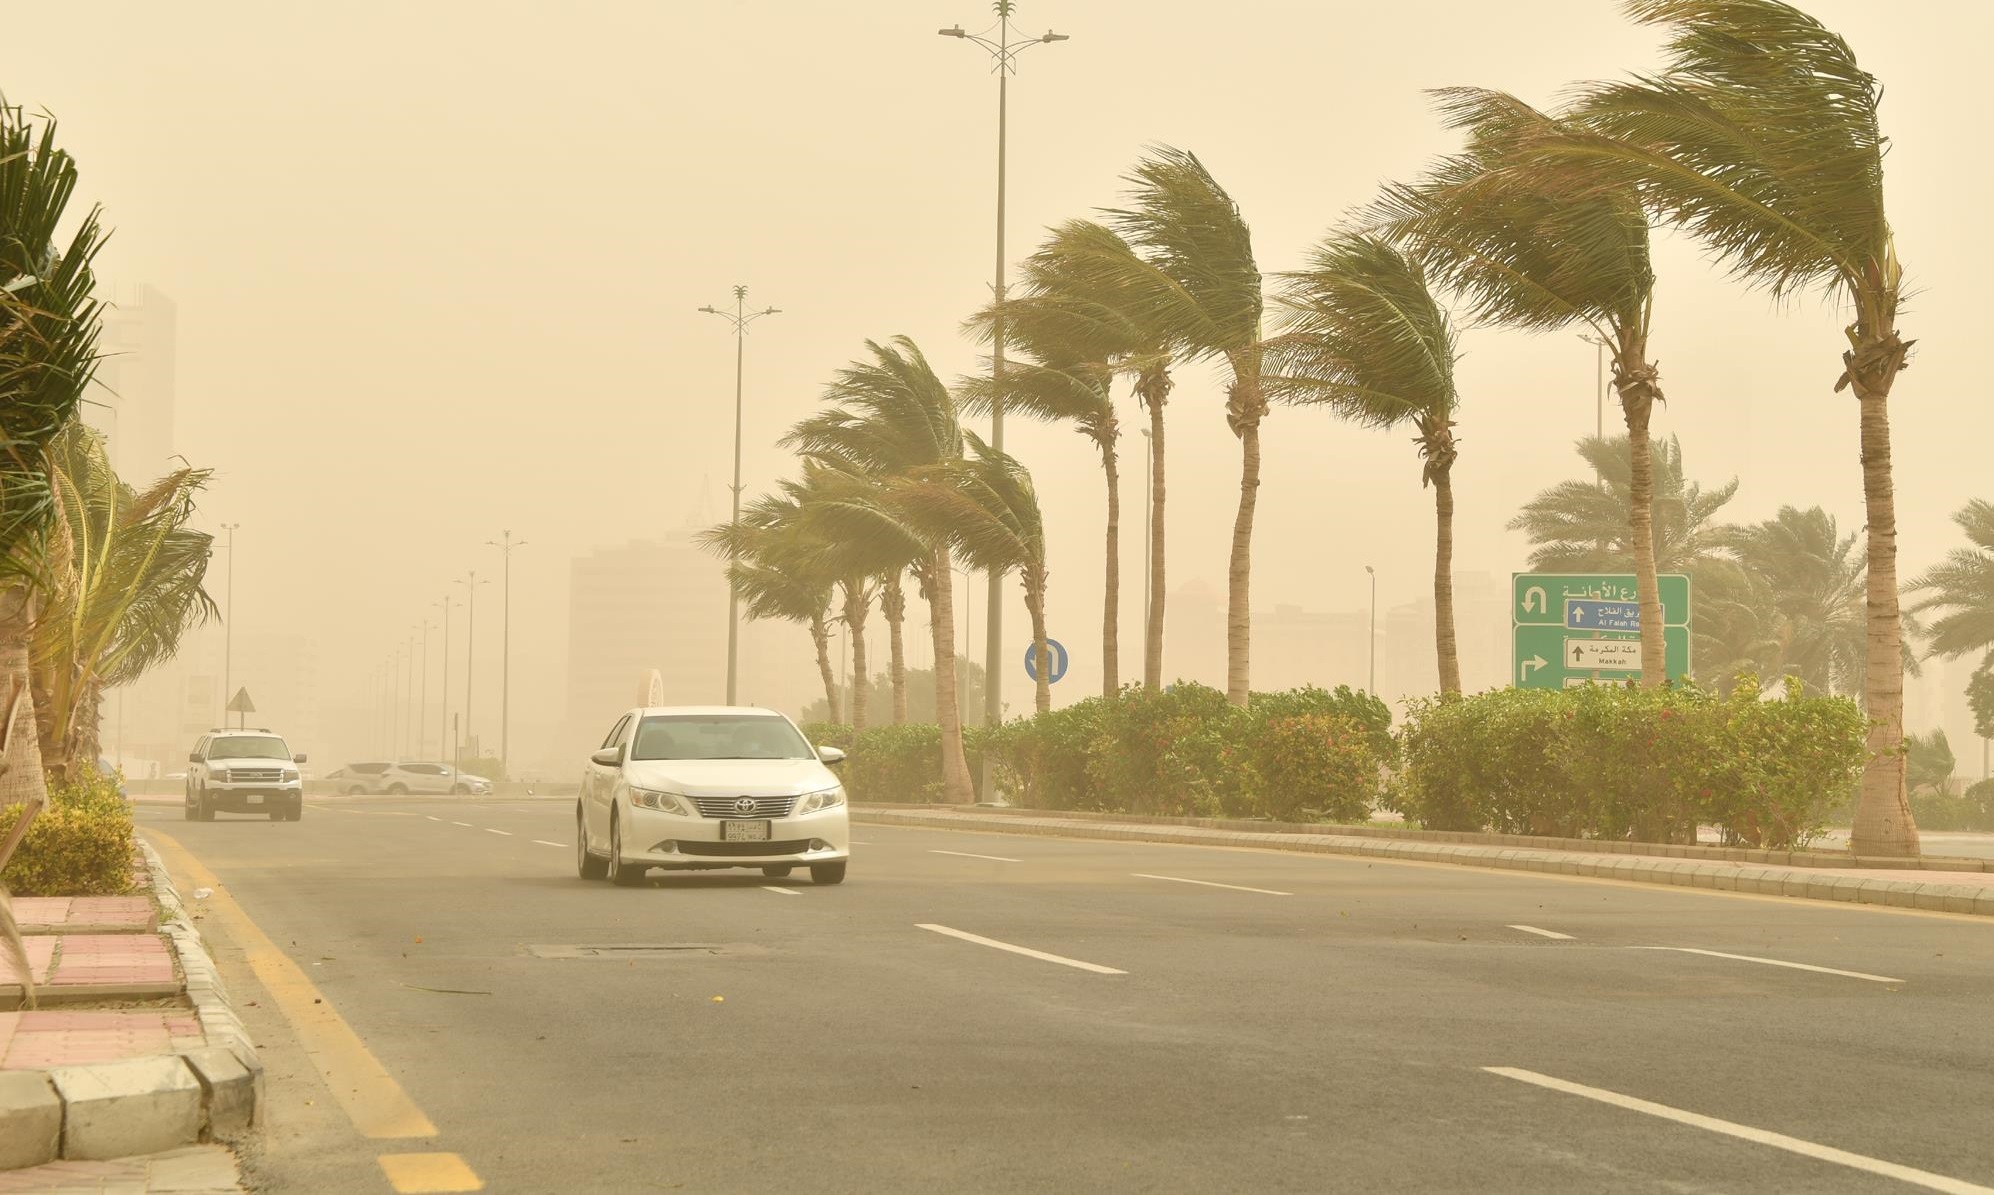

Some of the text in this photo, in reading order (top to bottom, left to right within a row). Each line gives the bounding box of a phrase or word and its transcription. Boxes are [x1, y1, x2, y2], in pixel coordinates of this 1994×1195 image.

[1620, 587, 1637, 601] رع
[1597, 606, 1640, 618] ريق الفلاح
[1609, 619, 1628, 627] Falah
[1589, 645, 1636, 655] مكة المكرمة
